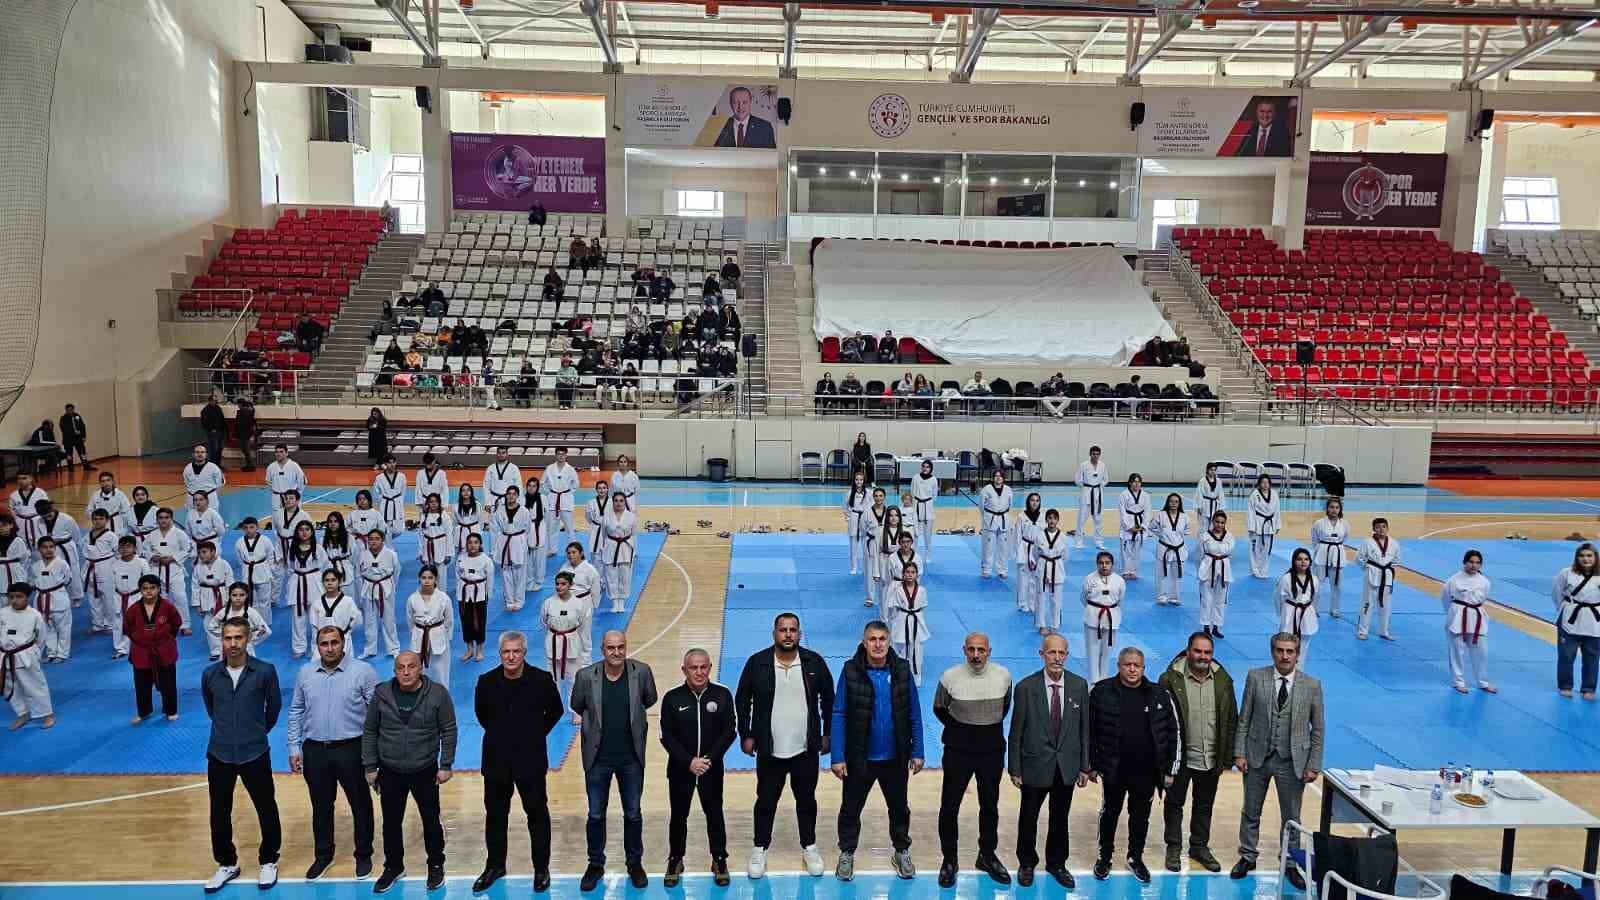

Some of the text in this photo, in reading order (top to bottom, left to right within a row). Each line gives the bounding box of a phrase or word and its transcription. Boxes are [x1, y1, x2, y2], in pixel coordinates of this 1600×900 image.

[917, 103, 1016, 114] TÜRKİYE CUMHURİYETİ
[917, 114, 1051, 126] GENÇLİK VE SPOR BAKANLIĞI
[559, 176, 597, 193] YERDE
[1404, 191, 1439, 206] YERDE
